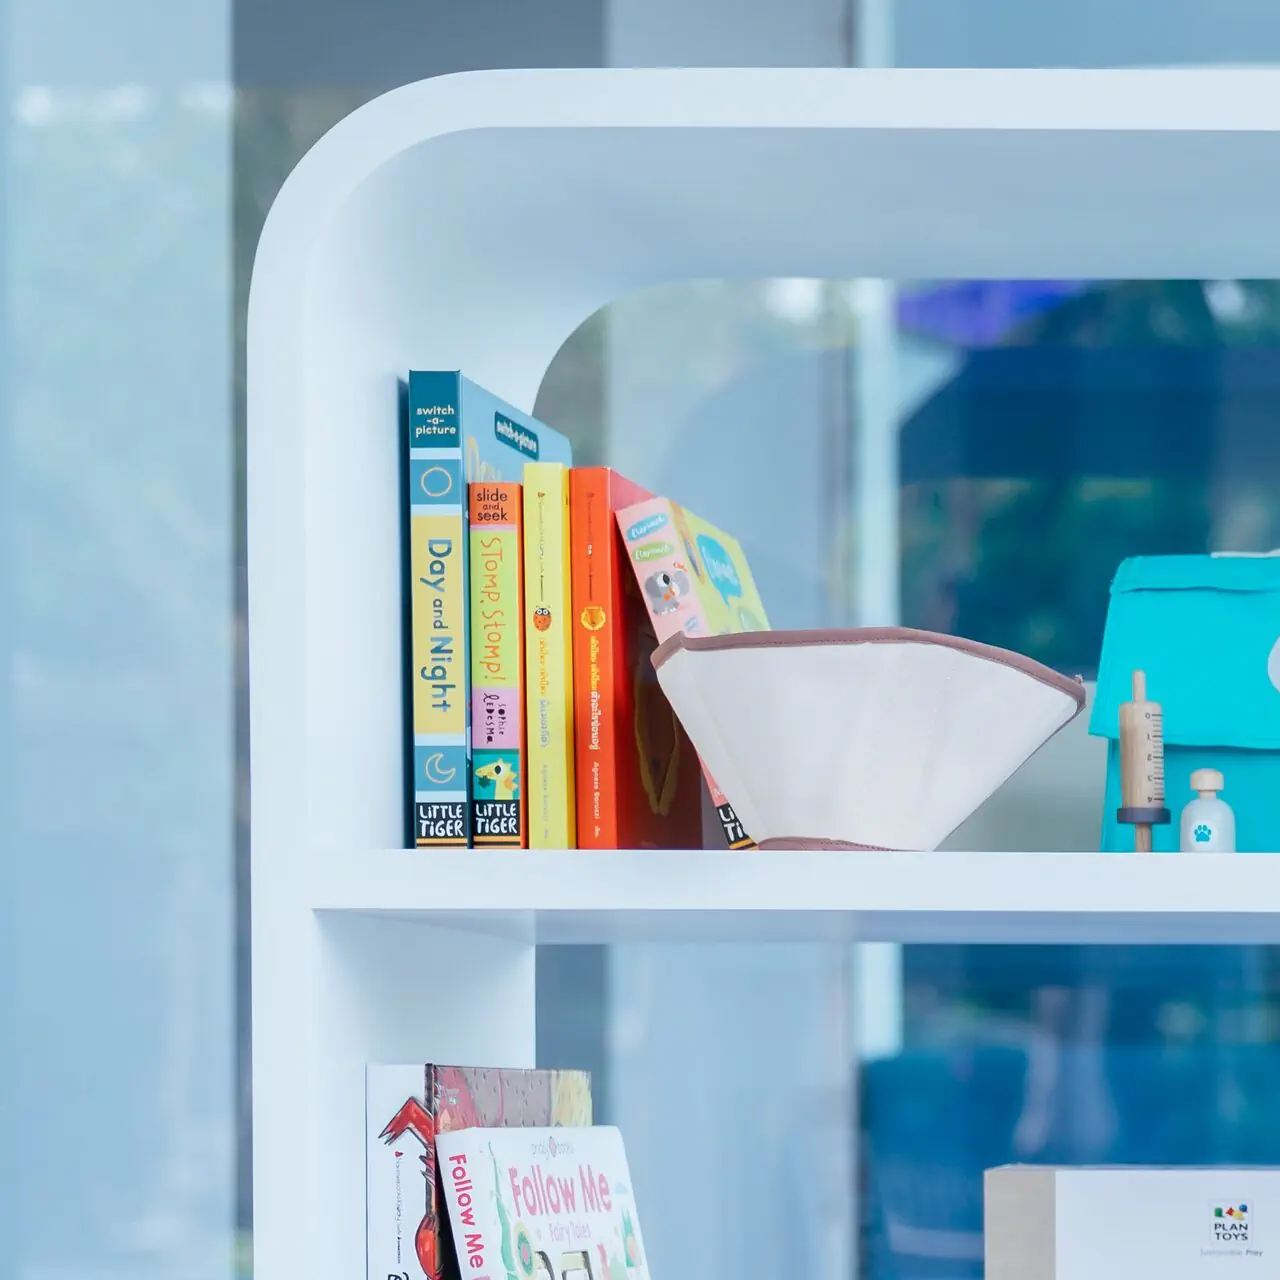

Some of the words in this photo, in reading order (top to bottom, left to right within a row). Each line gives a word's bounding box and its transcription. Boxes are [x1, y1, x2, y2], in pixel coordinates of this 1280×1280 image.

[417, 405, 455, 415] switch
[415, 426, 456, 438] picture
[477, 488, 508, 502] slide
[482, 502, 500, 510] and
[477, 508, 508, 521] seek
[420, 538, 452, 592] Day
[432, 598, 449, 629] and
[421, 636, 456, 712] Night
[508, 1164, 577, 1218] Follow
[578, 1163, 613, 1214] Me
[448, 1154, 475, 1227] Follow
[464, 1233, 485, 1270] Me
[1213, 1223, 1249, 1231] PLAN
[1214, 1232, 1249, 1241] TOYS
